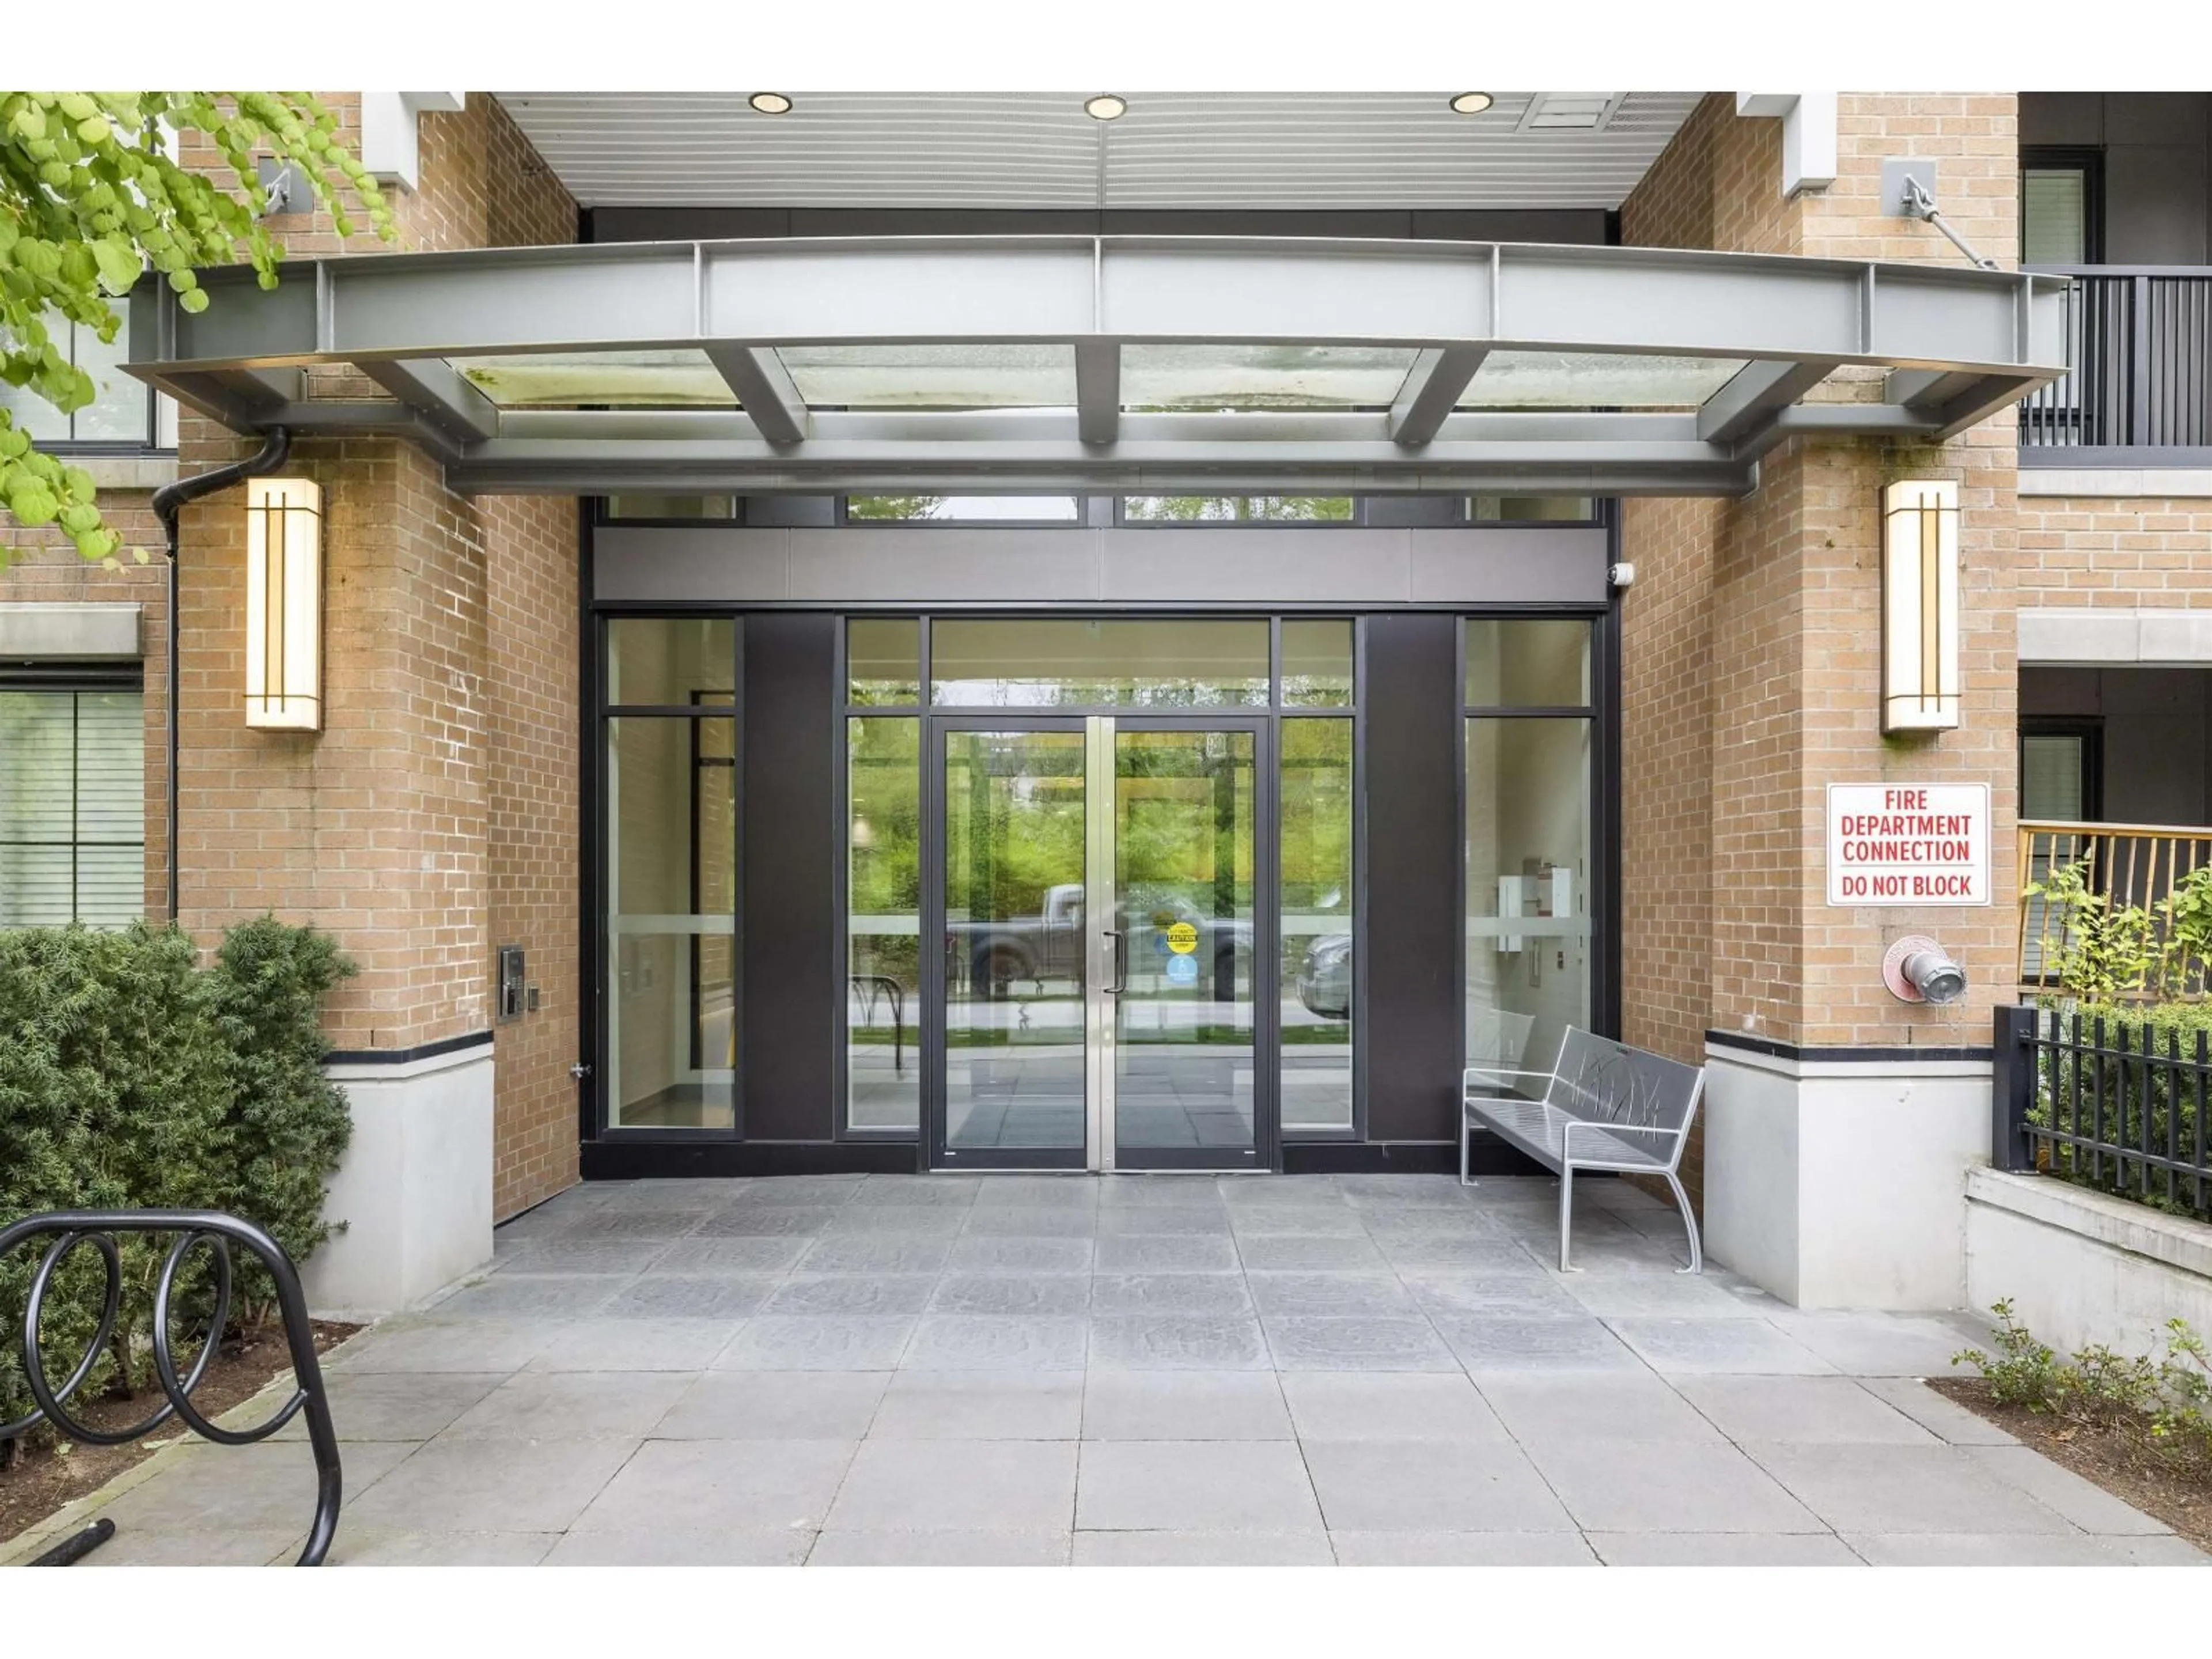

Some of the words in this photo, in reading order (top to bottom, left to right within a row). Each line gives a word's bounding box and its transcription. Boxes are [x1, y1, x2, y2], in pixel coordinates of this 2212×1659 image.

[1885, 790, 1927, 810] FIRE
[1842, 816, 1971, 835] DEPARTMENT
[1843, 840, 1969, 861] CONNECTION
[1843, 876, 1867, 895] DO
[1873, 876, 1908, 895] NOT
[1913, 876, 1971, 895] BLOCK
